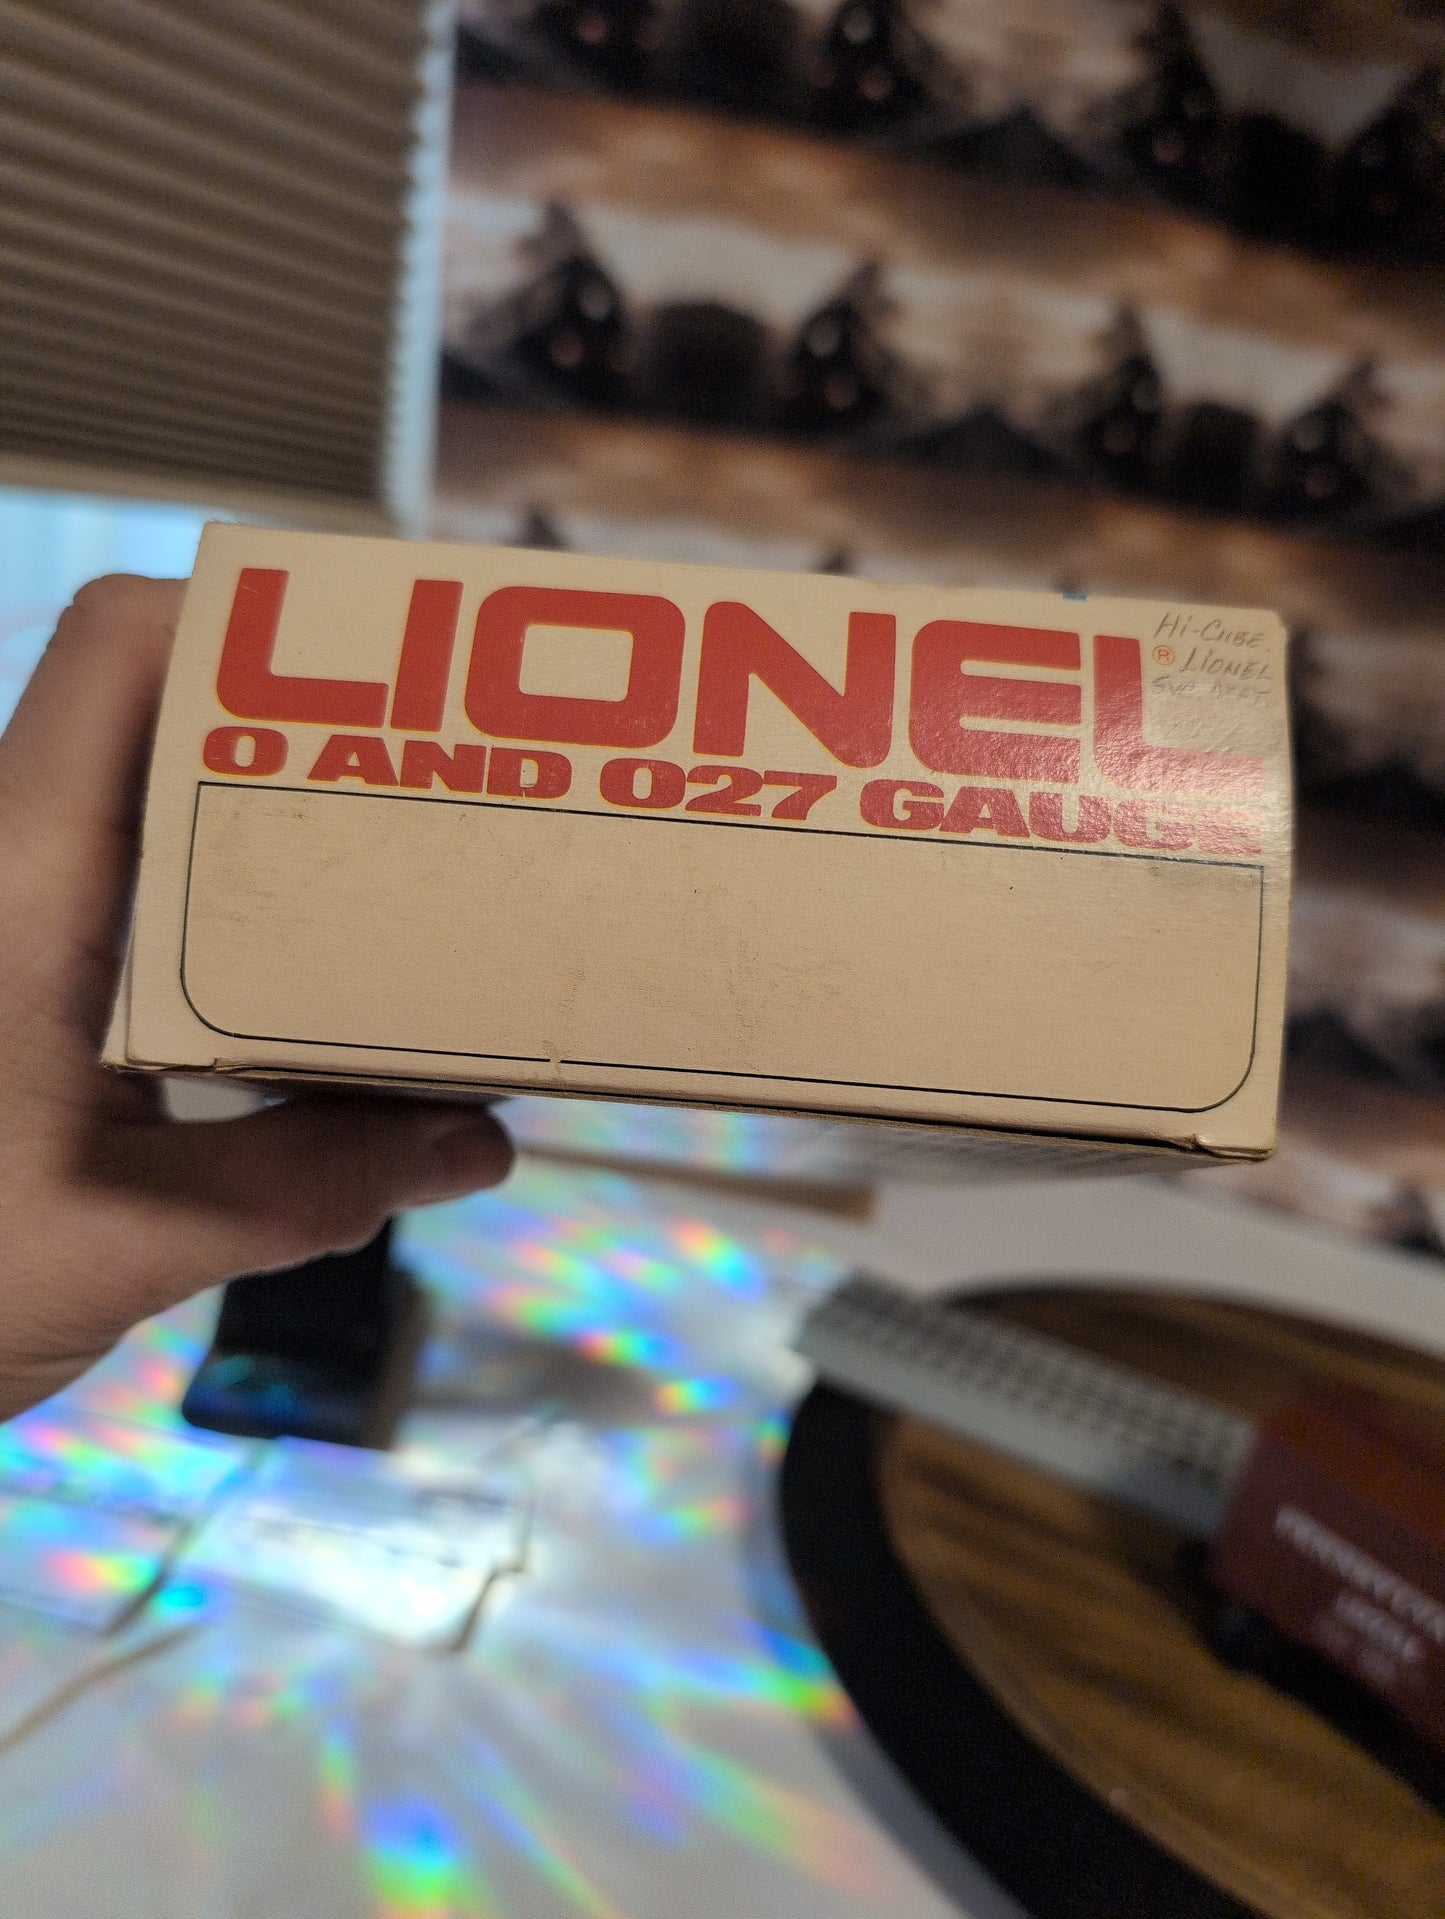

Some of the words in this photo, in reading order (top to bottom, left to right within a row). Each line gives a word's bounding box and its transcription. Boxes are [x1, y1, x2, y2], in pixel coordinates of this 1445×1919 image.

[214, 566, 1264, 800] LIONEL
[306, 733, 573, 800] AND
[859, 778, 1263, 856] GAUGE
